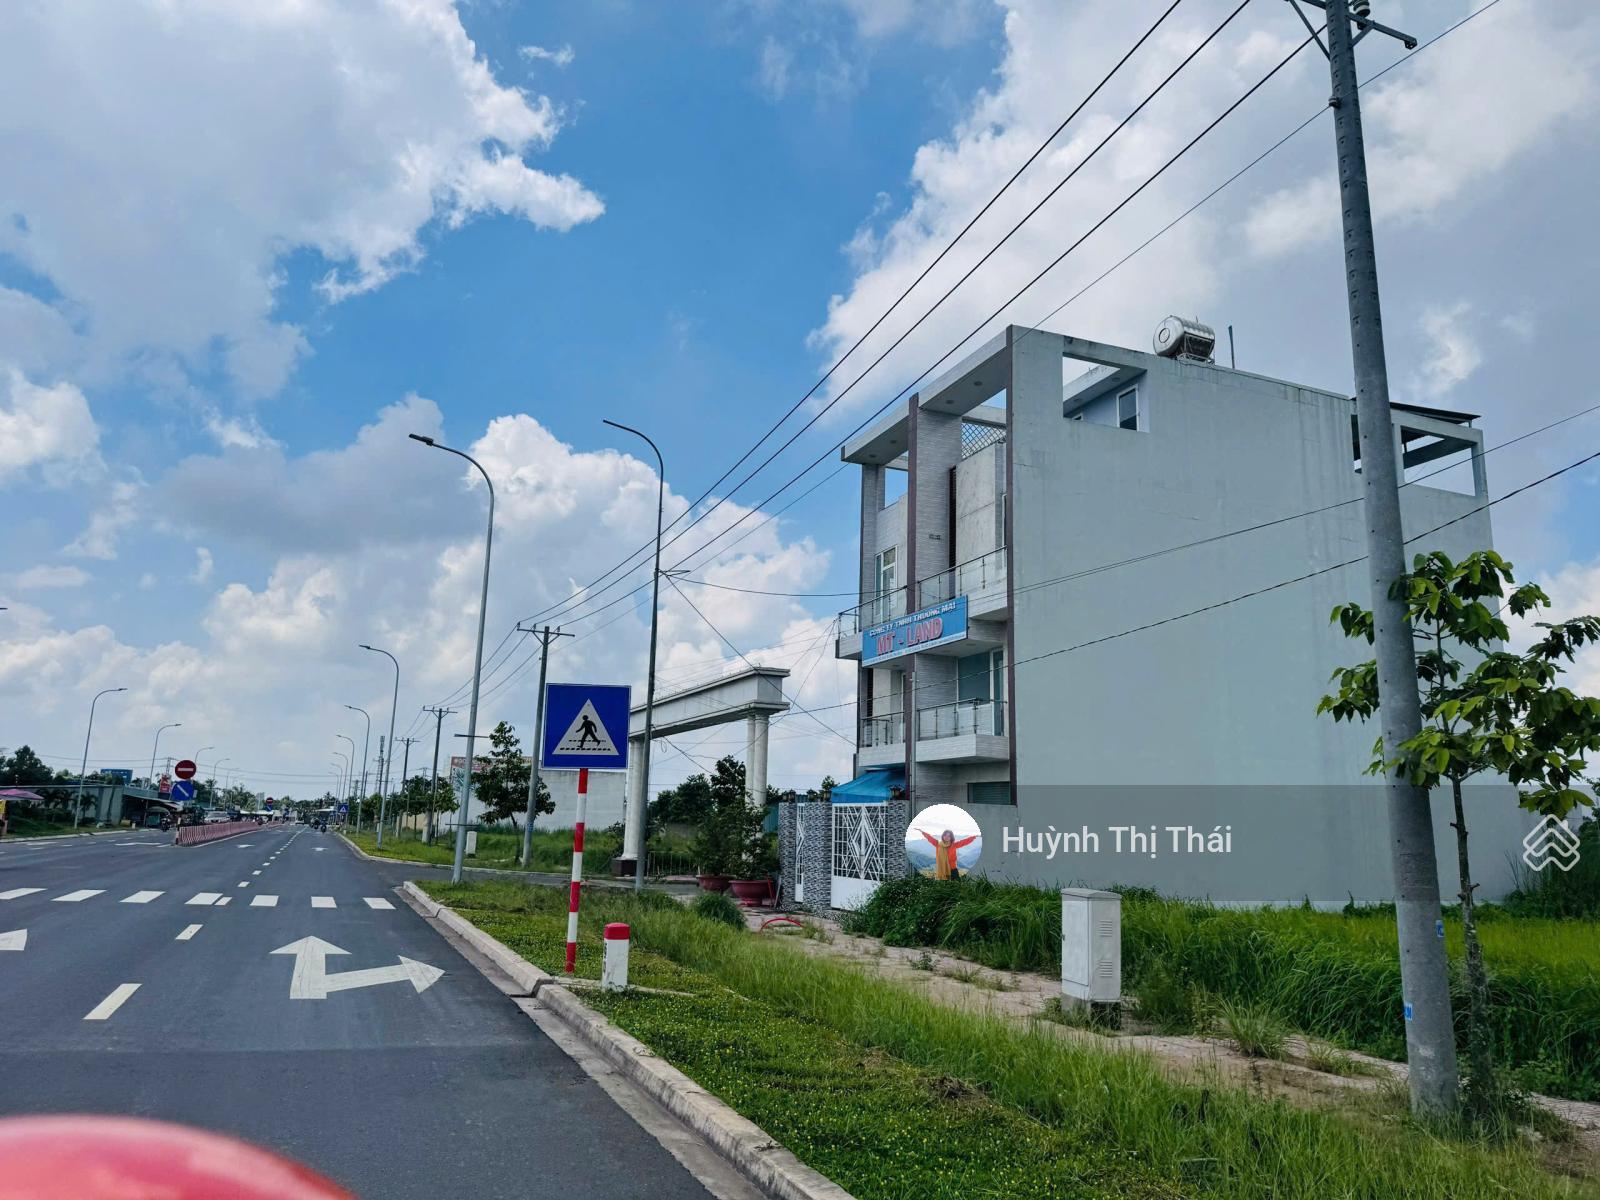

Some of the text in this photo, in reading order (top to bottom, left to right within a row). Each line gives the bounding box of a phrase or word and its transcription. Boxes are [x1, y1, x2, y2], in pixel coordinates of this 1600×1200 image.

[877, 633, 896, 655] MT
[907, 617, 943, 646] LAND
[885, 623, 893, 632] TY
[895, 617, 912, 628] TNHH
